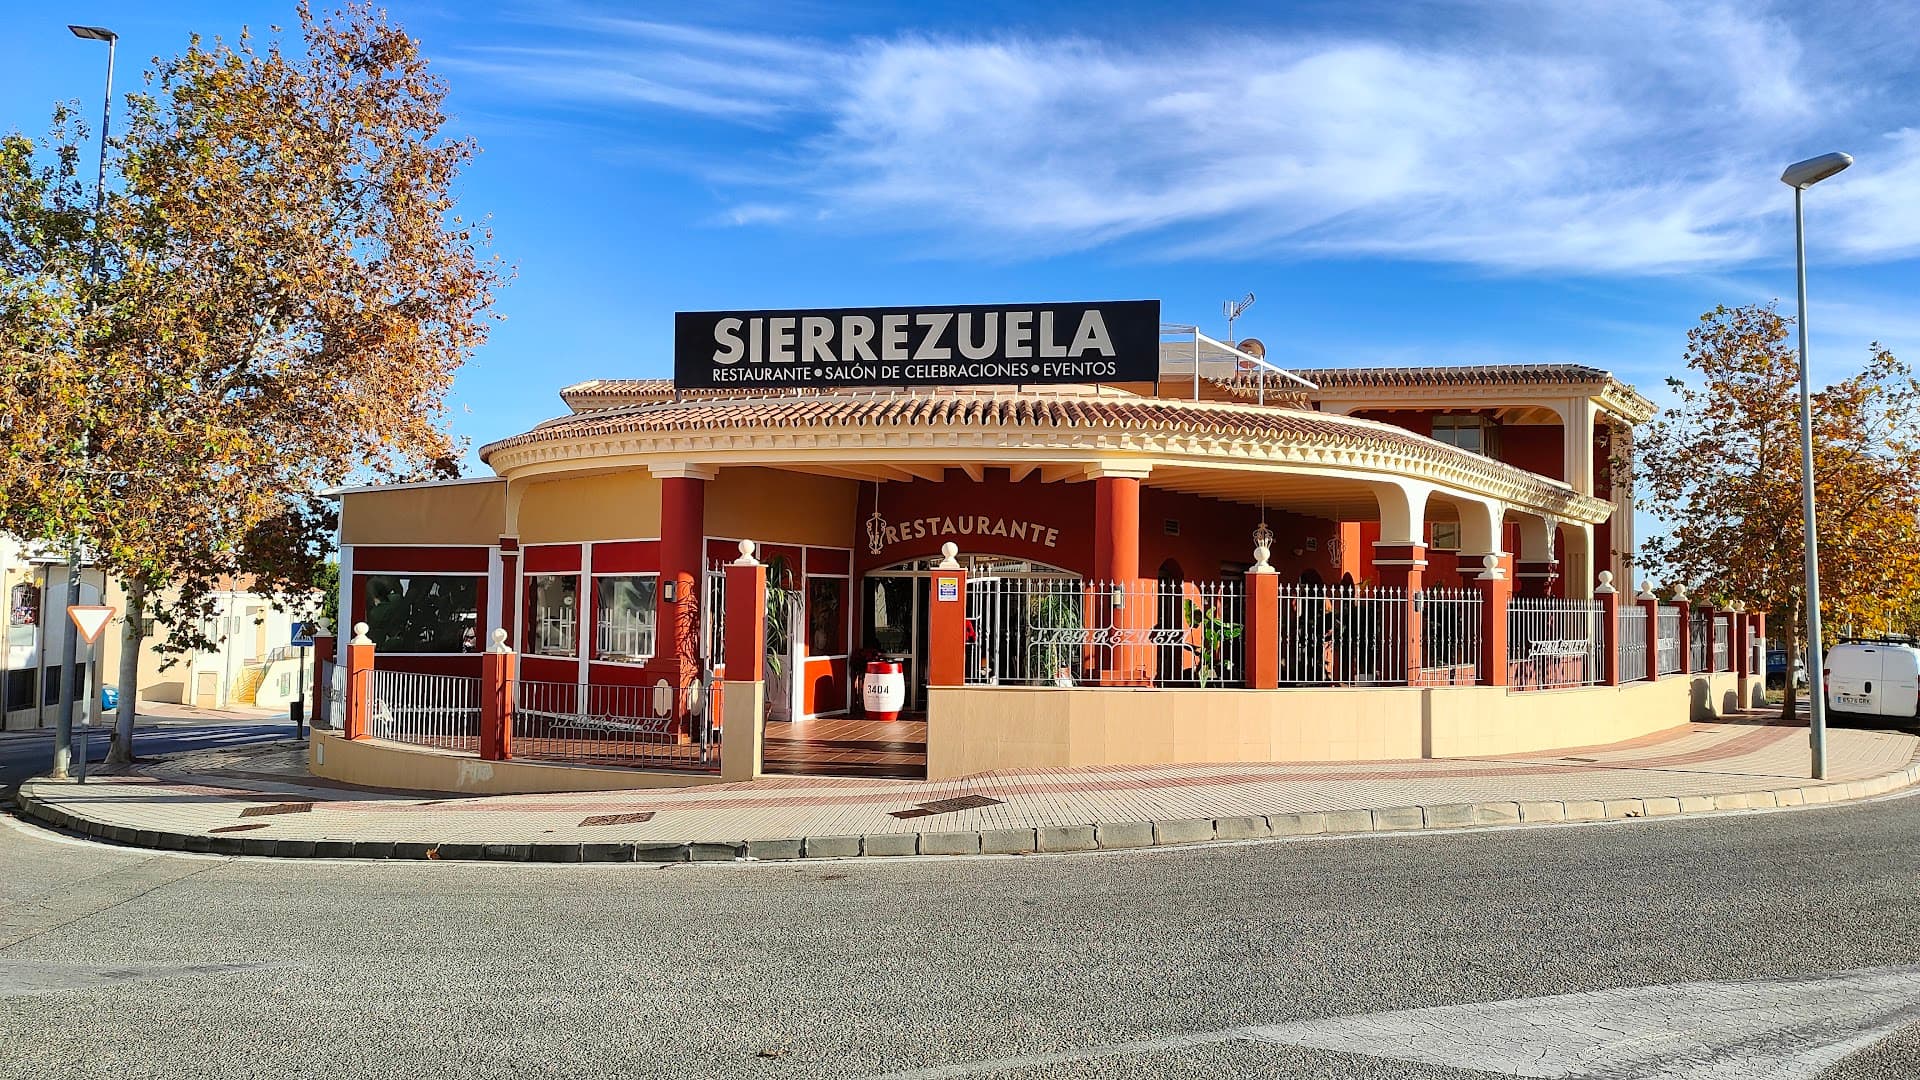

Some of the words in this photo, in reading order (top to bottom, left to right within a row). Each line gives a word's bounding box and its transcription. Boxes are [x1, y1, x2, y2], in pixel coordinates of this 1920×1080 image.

[712, 310, 1117, 365] SIERREZUELA
[712, 366, 812, 382] RESTAURANTE
[824, 362, 877, 380] SALÓN
[881, 365, 900, 379] DE
[904, 363, 1029, 379] CELEBRACIONES
[1042, 361, 1117, 377] EVENTOS
[885, 515, 1060, 548] RESTAURANTE
[867, 684, 889, 695] 3404
